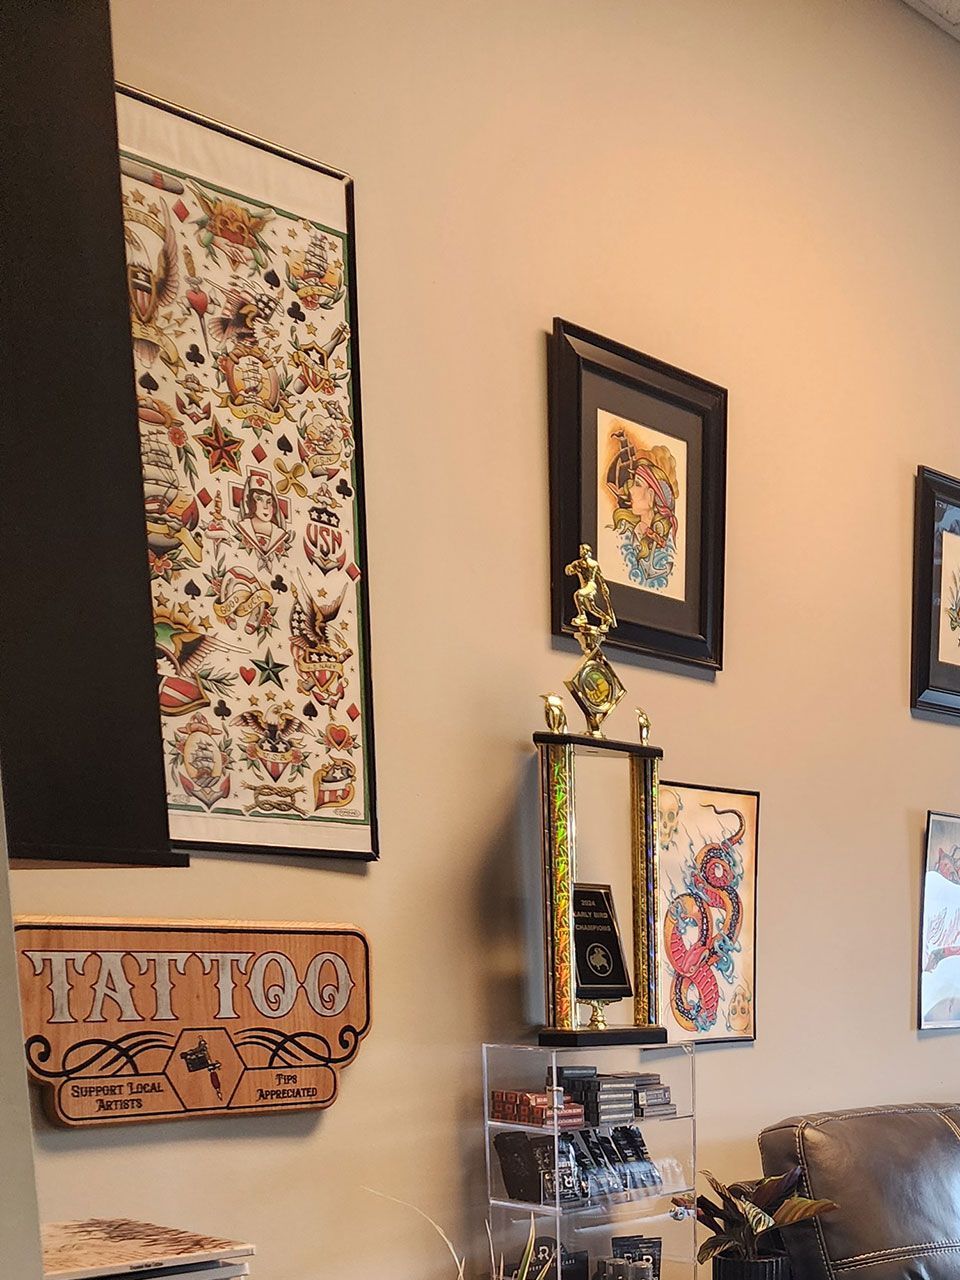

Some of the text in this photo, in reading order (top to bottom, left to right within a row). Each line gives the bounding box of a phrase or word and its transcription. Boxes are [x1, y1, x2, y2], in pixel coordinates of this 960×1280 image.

[306, 523, 342, 558] USN
[220, 593, 264, 615] GOOD LUCK
[575, 924, 611, 932] CHAMPIONS
[22, 950, 356, 1024] TATTOO
[275, 1073, 298, 1086] TIPS
[71, 1081, 164, 1098] SUPPORT LOCAL
[255, 1087, 318, 1103] APPRECIATED
[96, 1098, 143, 1112] ARTISTS
